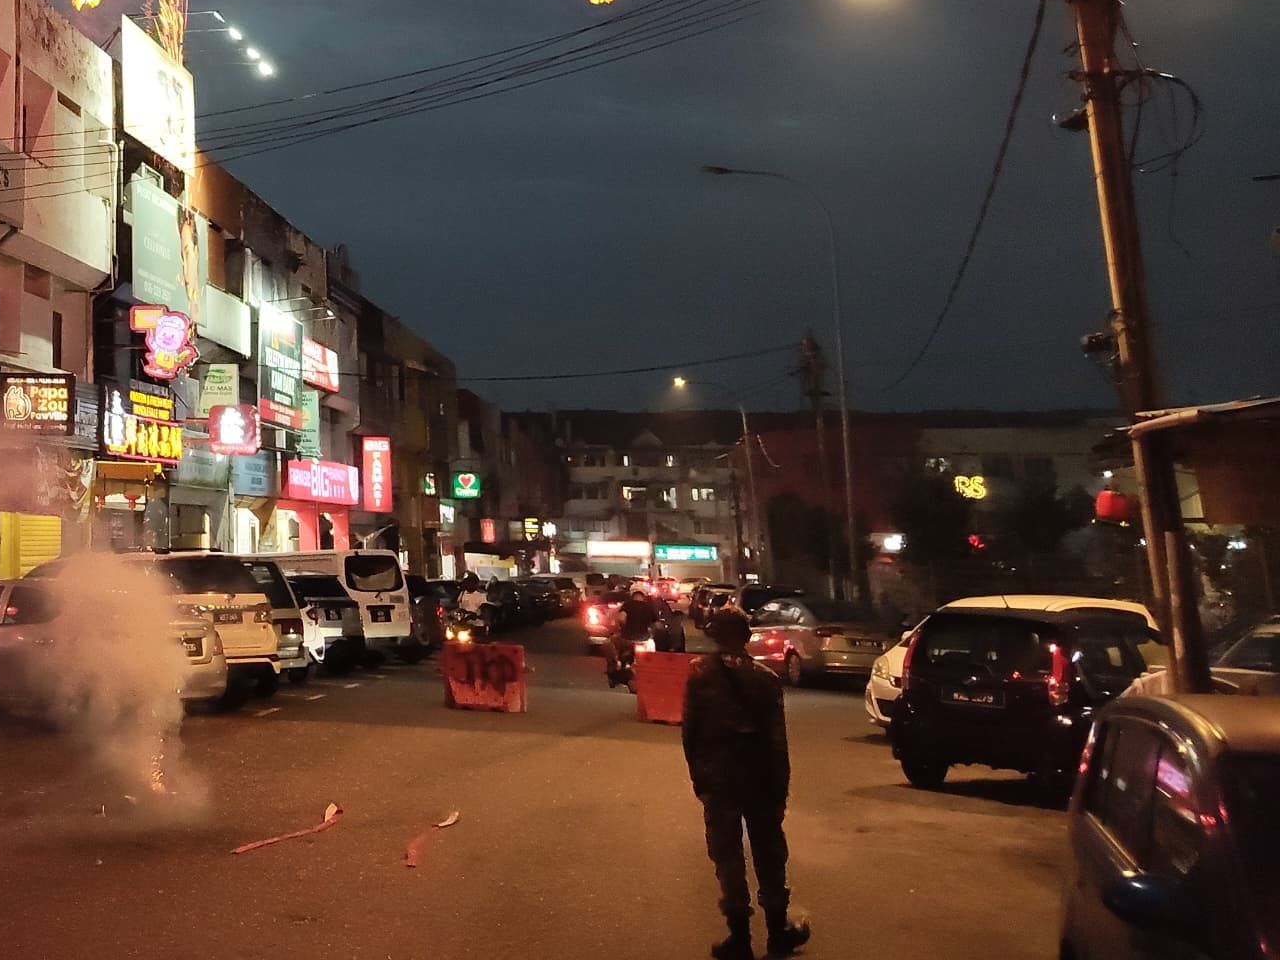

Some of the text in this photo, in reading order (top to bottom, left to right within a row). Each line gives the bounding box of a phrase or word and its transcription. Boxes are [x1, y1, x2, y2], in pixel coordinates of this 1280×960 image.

[30, 386, 68, 400] Papa
[38, 399, 68, 412] Zou
[364, 440, 389, 451] BIG
[311, 463, 329, 497] BIG
